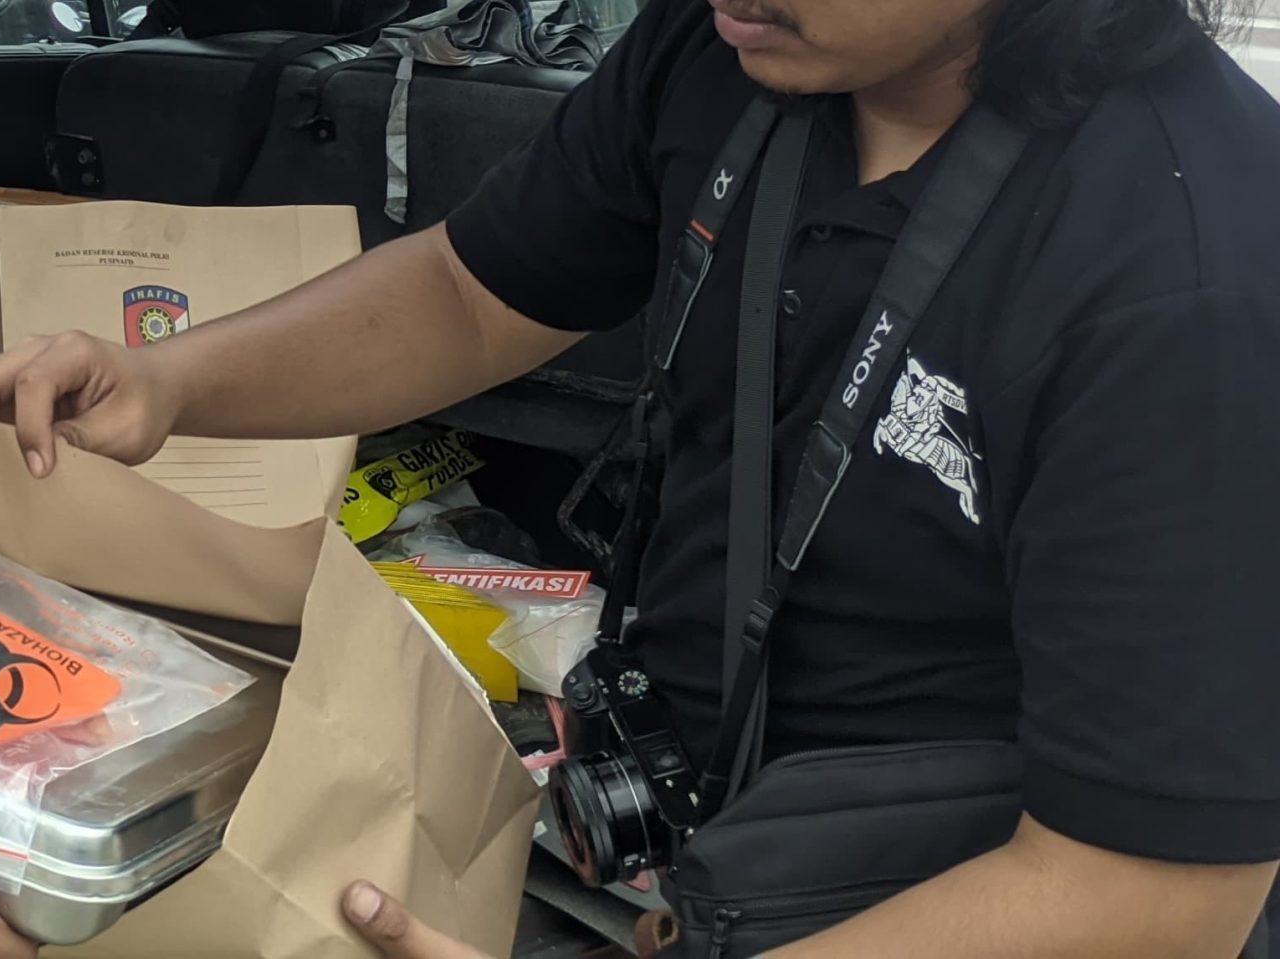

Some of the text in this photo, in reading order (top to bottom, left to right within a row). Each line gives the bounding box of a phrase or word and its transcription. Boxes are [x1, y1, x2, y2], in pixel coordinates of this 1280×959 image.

[55, 250, 82, 258] BADAN
[130, 288, 180, 304] INAFIS
[842, 310, 893, 408] SONY
[427, 573, 576, 592] ENTIFIKASI
